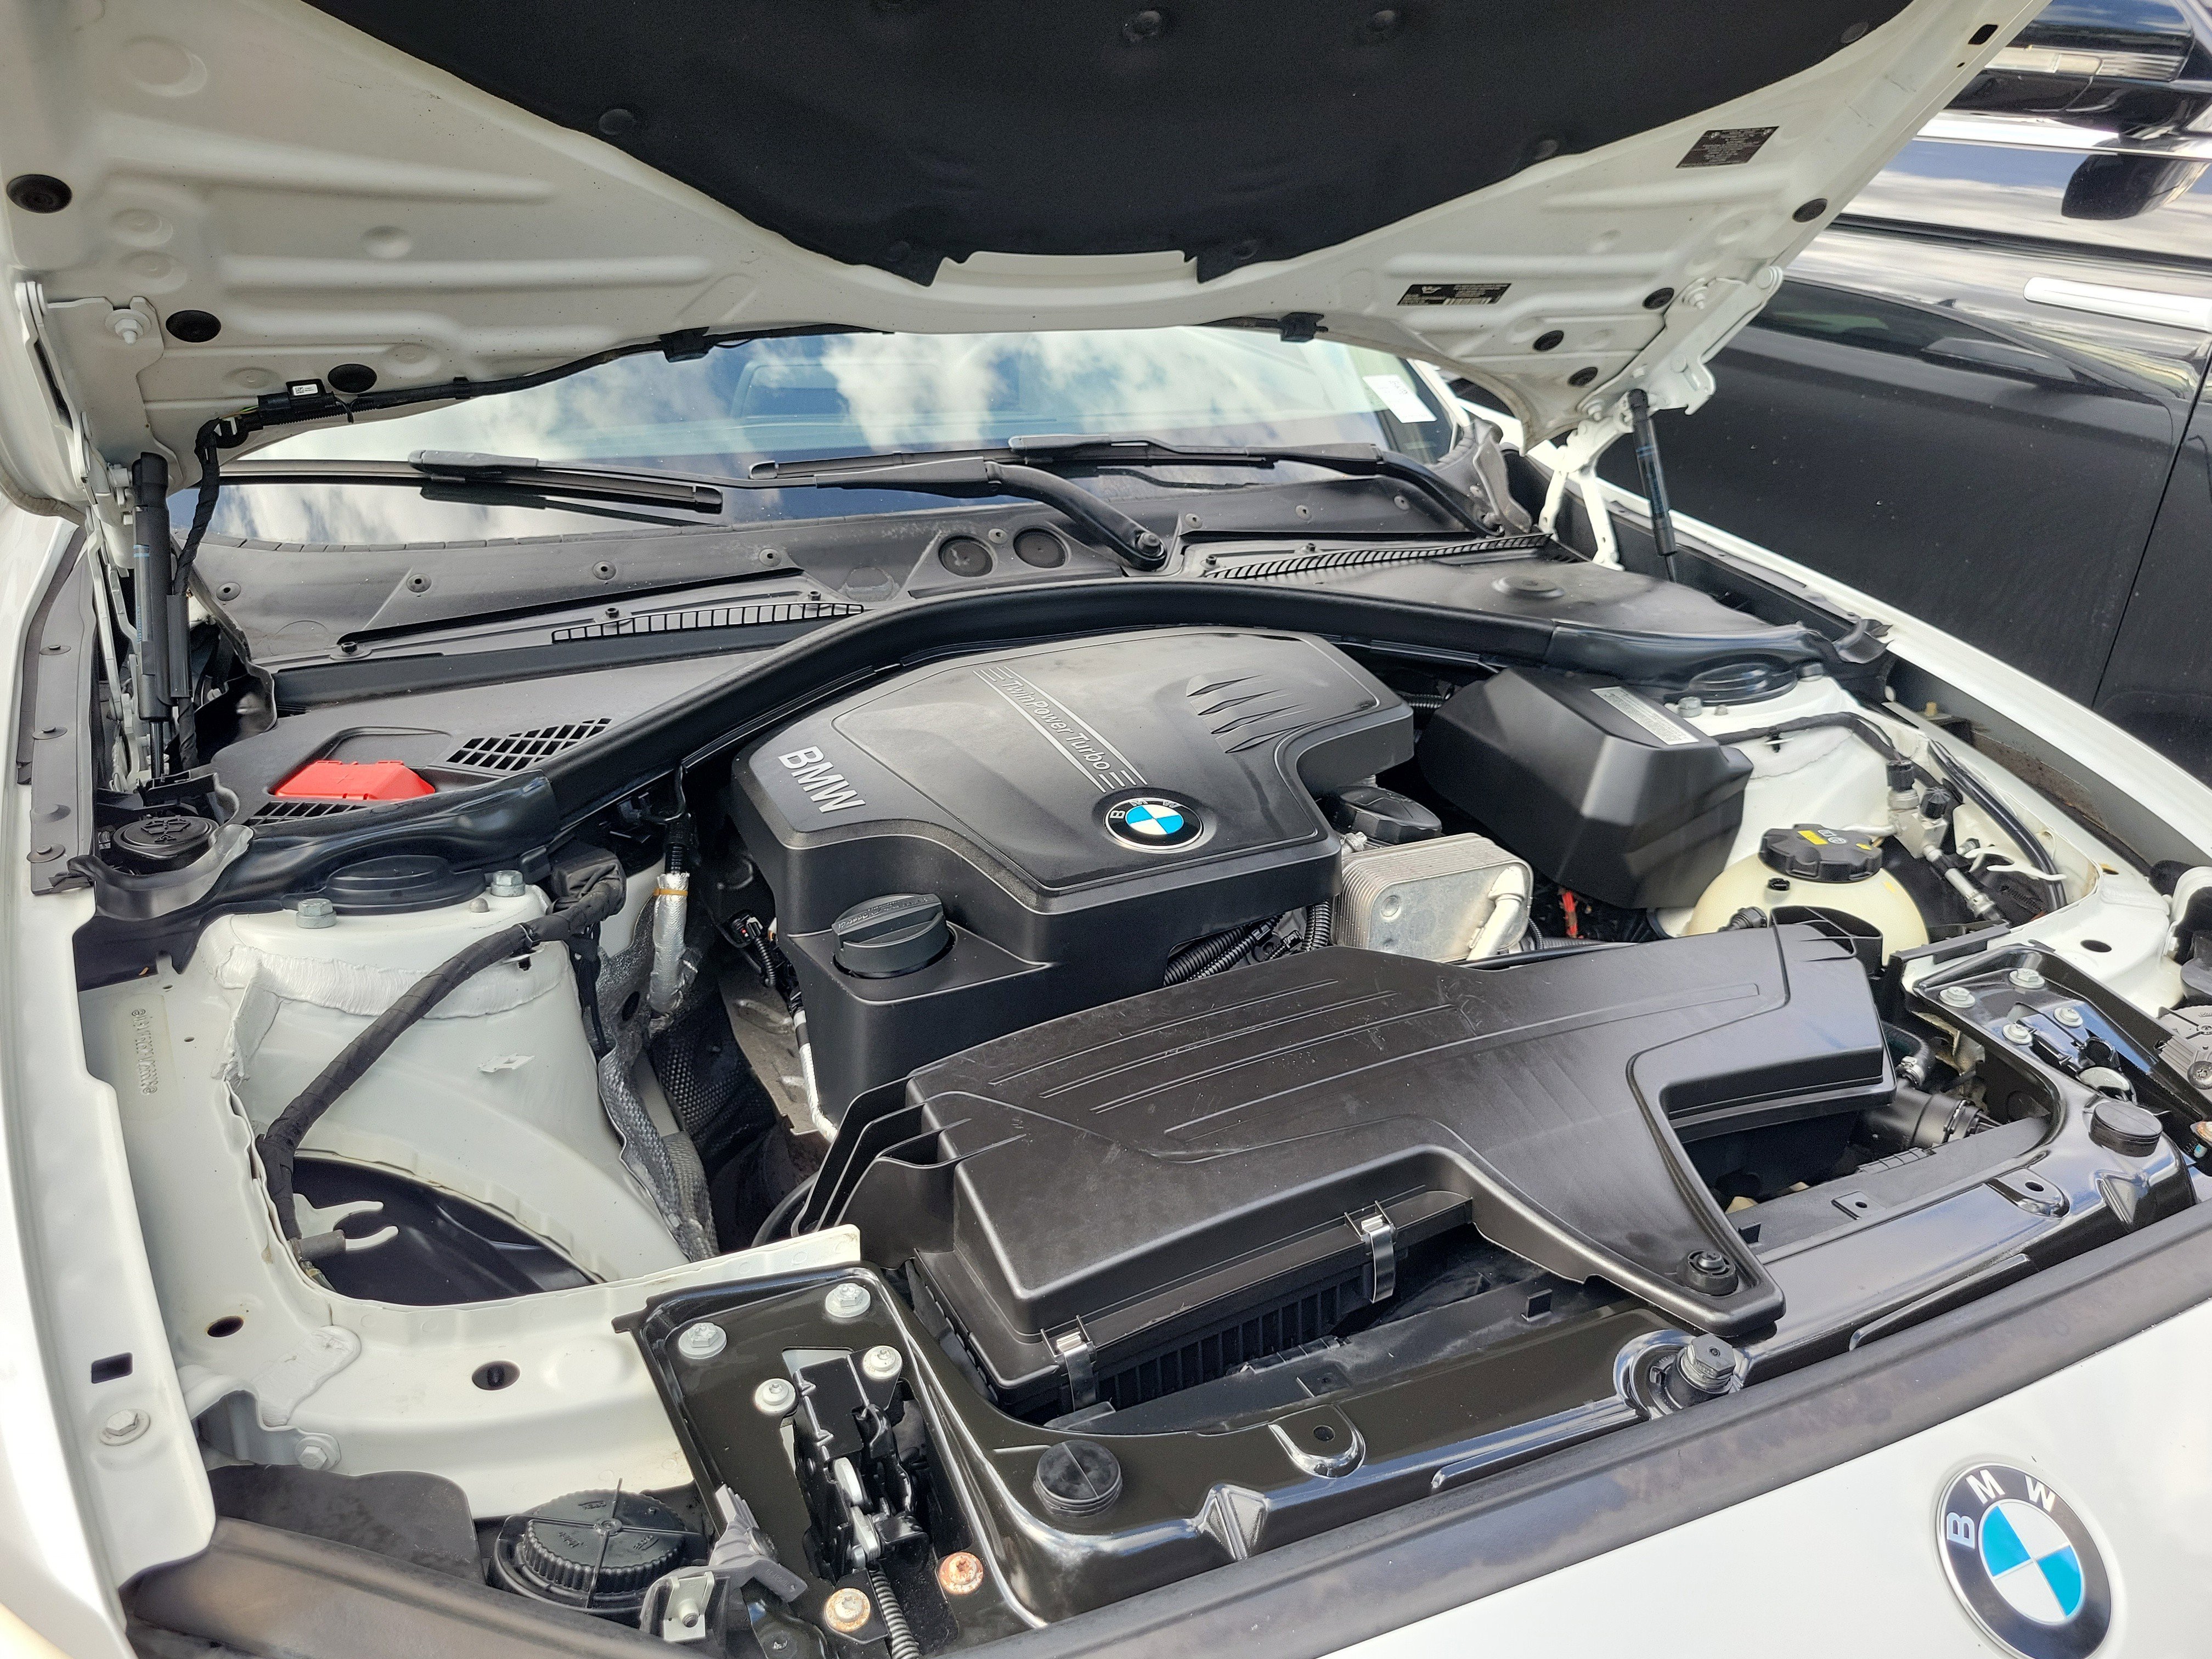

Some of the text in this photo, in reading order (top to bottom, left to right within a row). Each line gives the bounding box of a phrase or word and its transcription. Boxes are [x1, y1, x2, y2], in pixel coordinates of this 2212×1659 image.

[1002, 680, 1110, 770] TwinPower Turbo
[778, 746, 866, 814] BMW
[1109, 798, 1180, 819] BMW
[1946, 1469, 2056, 1549] BMW
